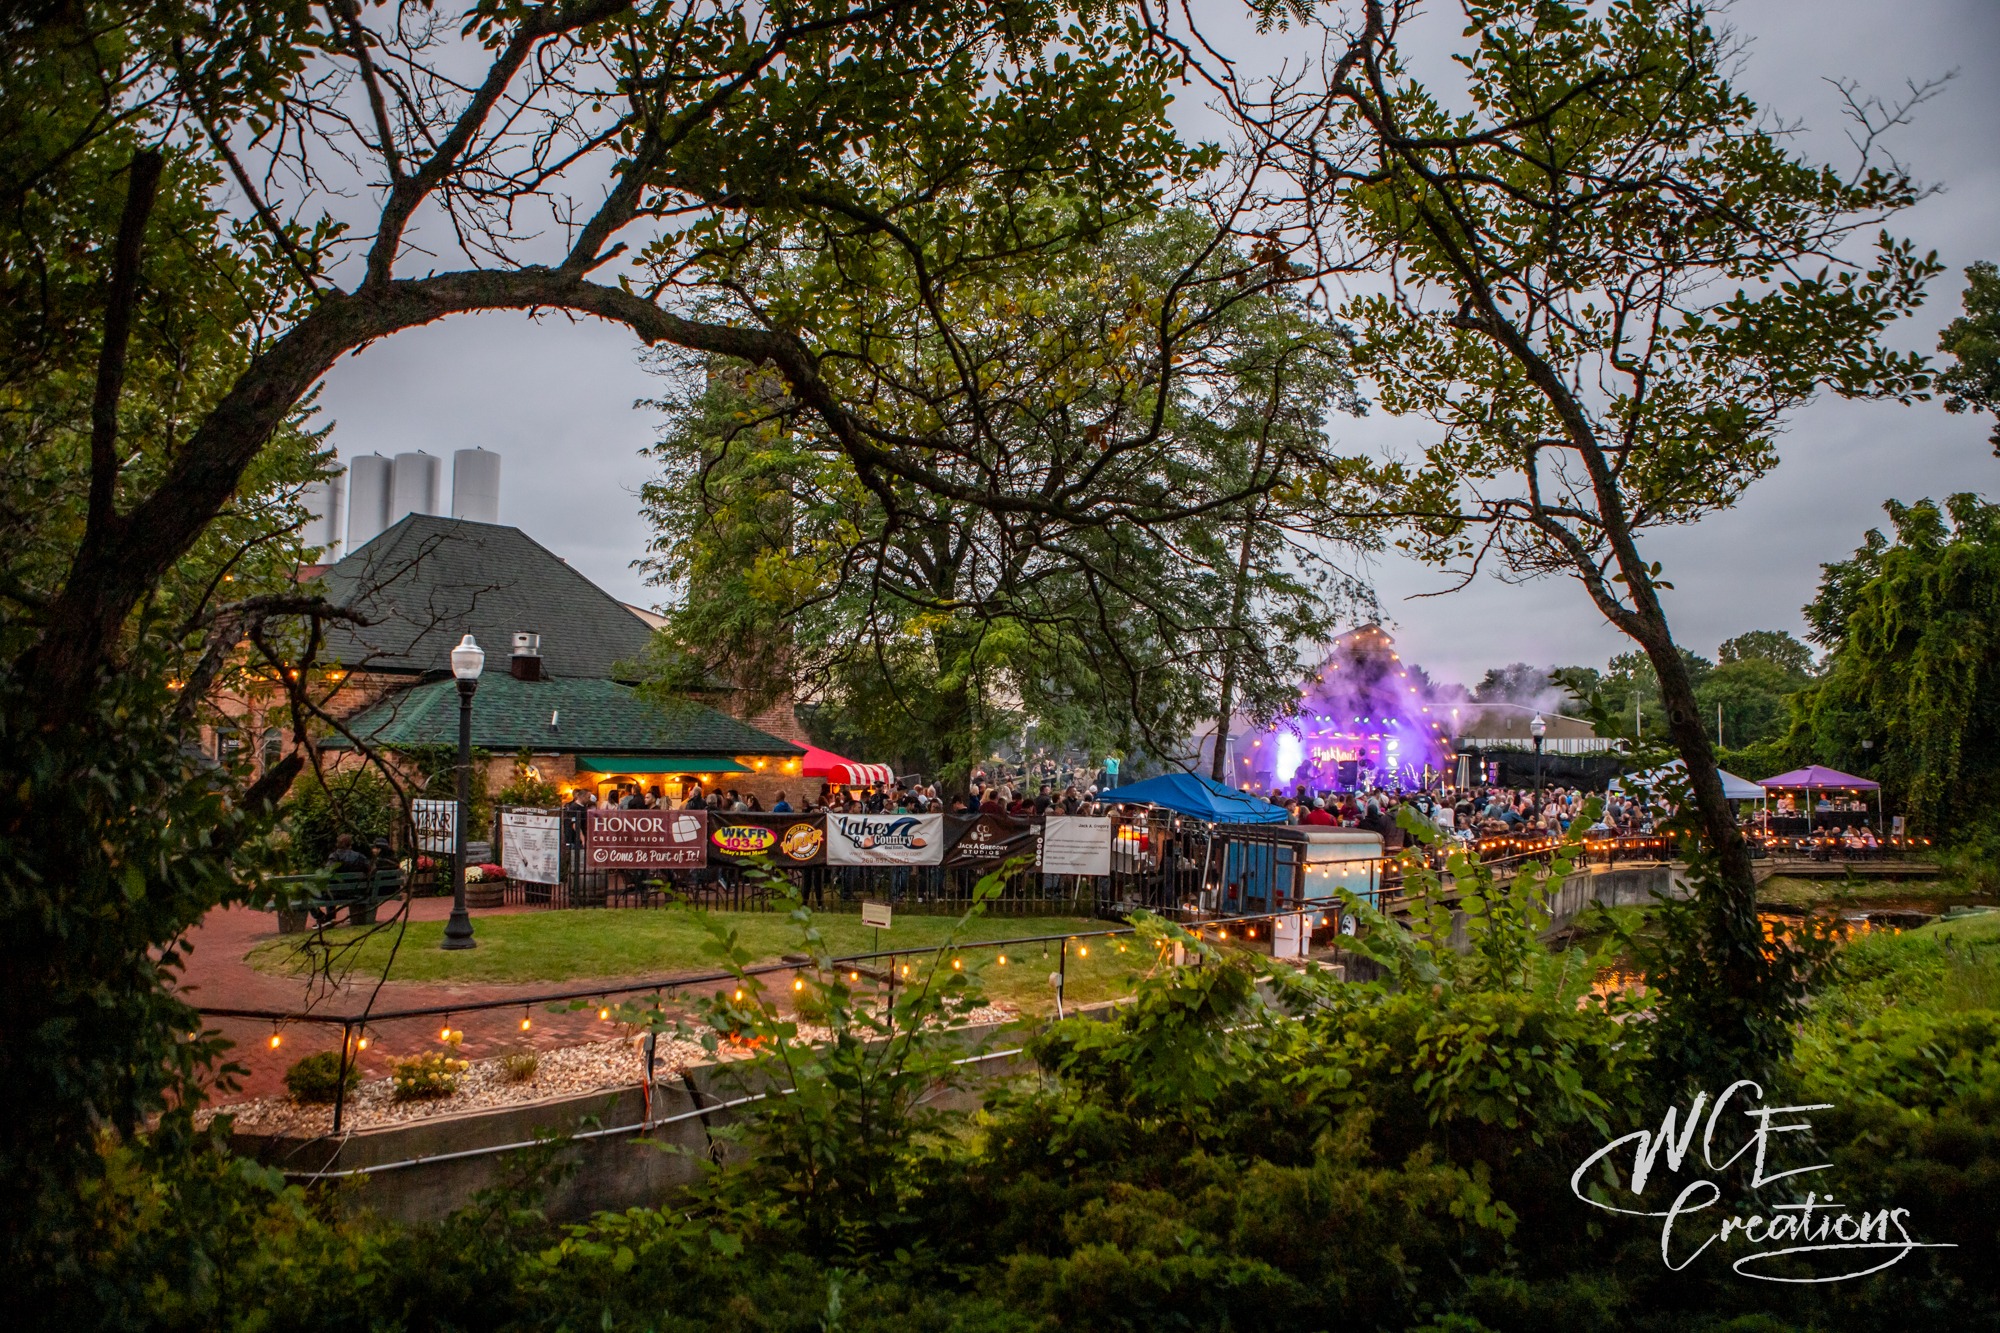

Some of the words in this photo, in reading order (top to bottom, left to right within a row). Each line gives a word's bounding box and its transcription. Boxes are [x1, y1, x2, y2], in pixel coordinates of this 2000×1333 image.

[594, 817, 666, 833] HONOR
[839, 816, 891, 837] Lakes
[721, 827, 768, 839] WKFR
[725, 838, 764, 850] 103.3
[780, 830, 822, 854] WRKR
[853, 835, 863, 849] &
[873, 834, 914, 847] Country
[979, 843, 1008, 851] GREGORY
[610, 850, 634, 862] Come
[635, 850, 648, 862] Be
[649, 850, 672, 862] Part
[673, 850, 684, 863] of
[686, 850, 700, 862] It!
